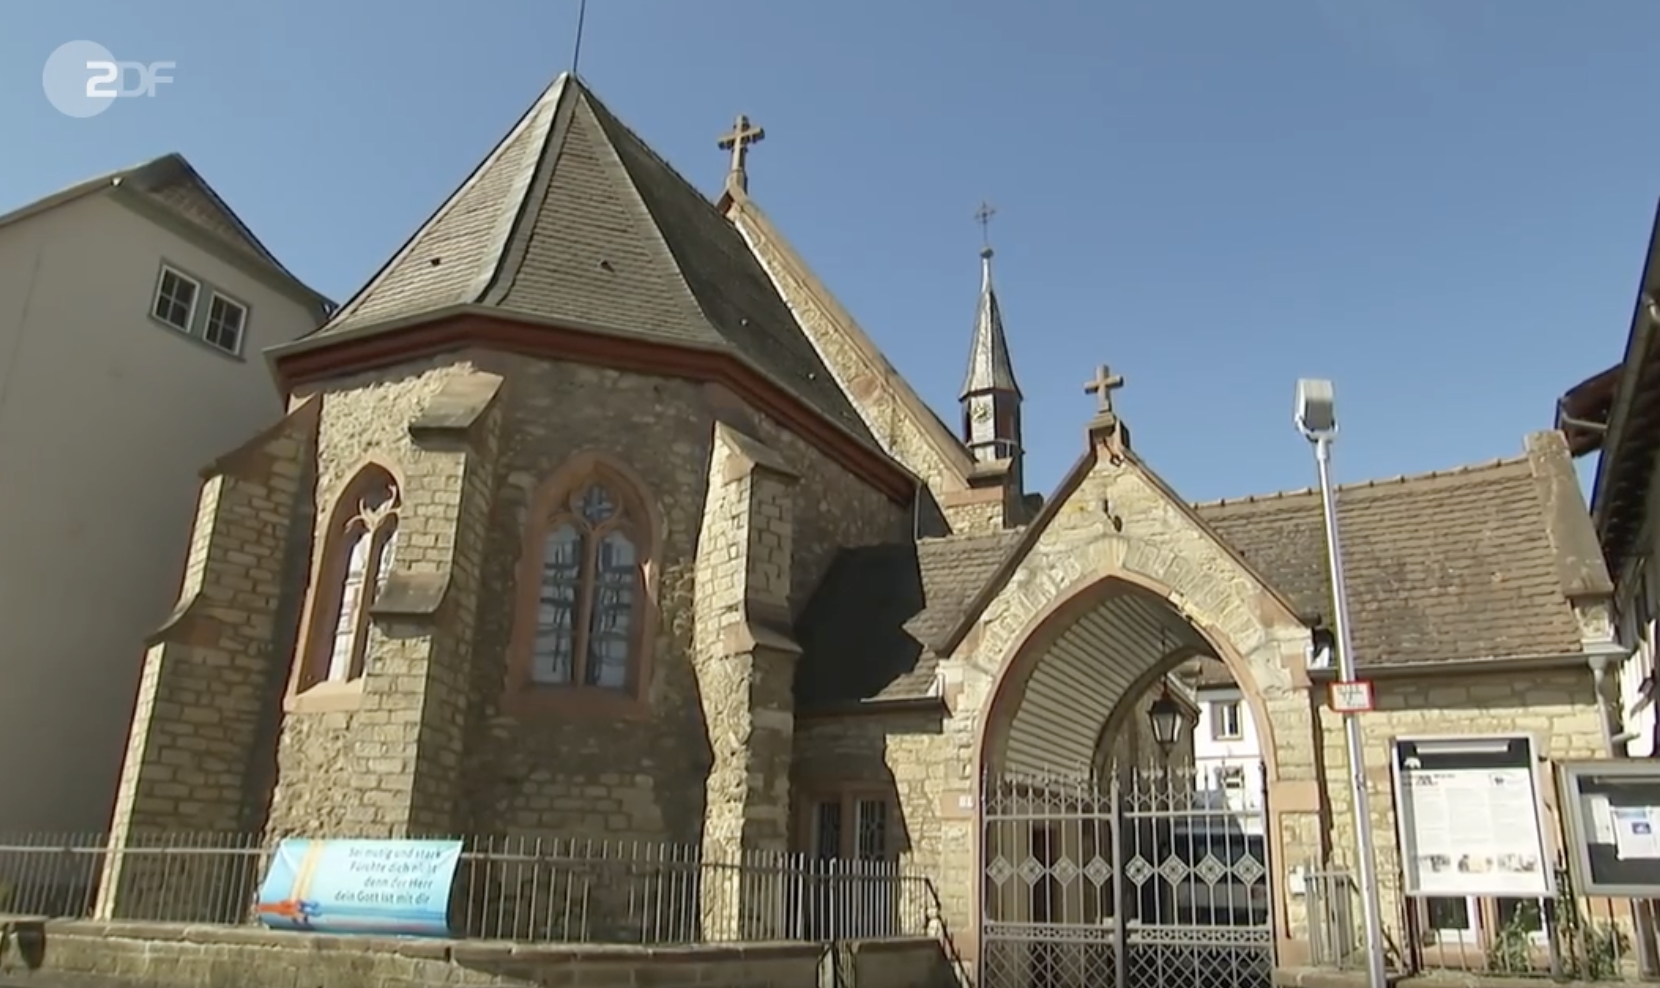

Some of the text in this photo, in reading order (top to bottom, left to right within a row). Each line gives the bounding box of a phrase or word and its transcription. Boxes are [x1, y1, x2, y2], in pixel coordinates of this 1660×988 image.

[365, 848, 392, 860] mutig
[395, 848, 414, 859] und
[416, 849, 441, 859] stark
[388, 861, 410, 873] dich
[364, 876, 433, 889] denn der Herr
[335, 890, 430, 905] dein Gott ist mit dir
